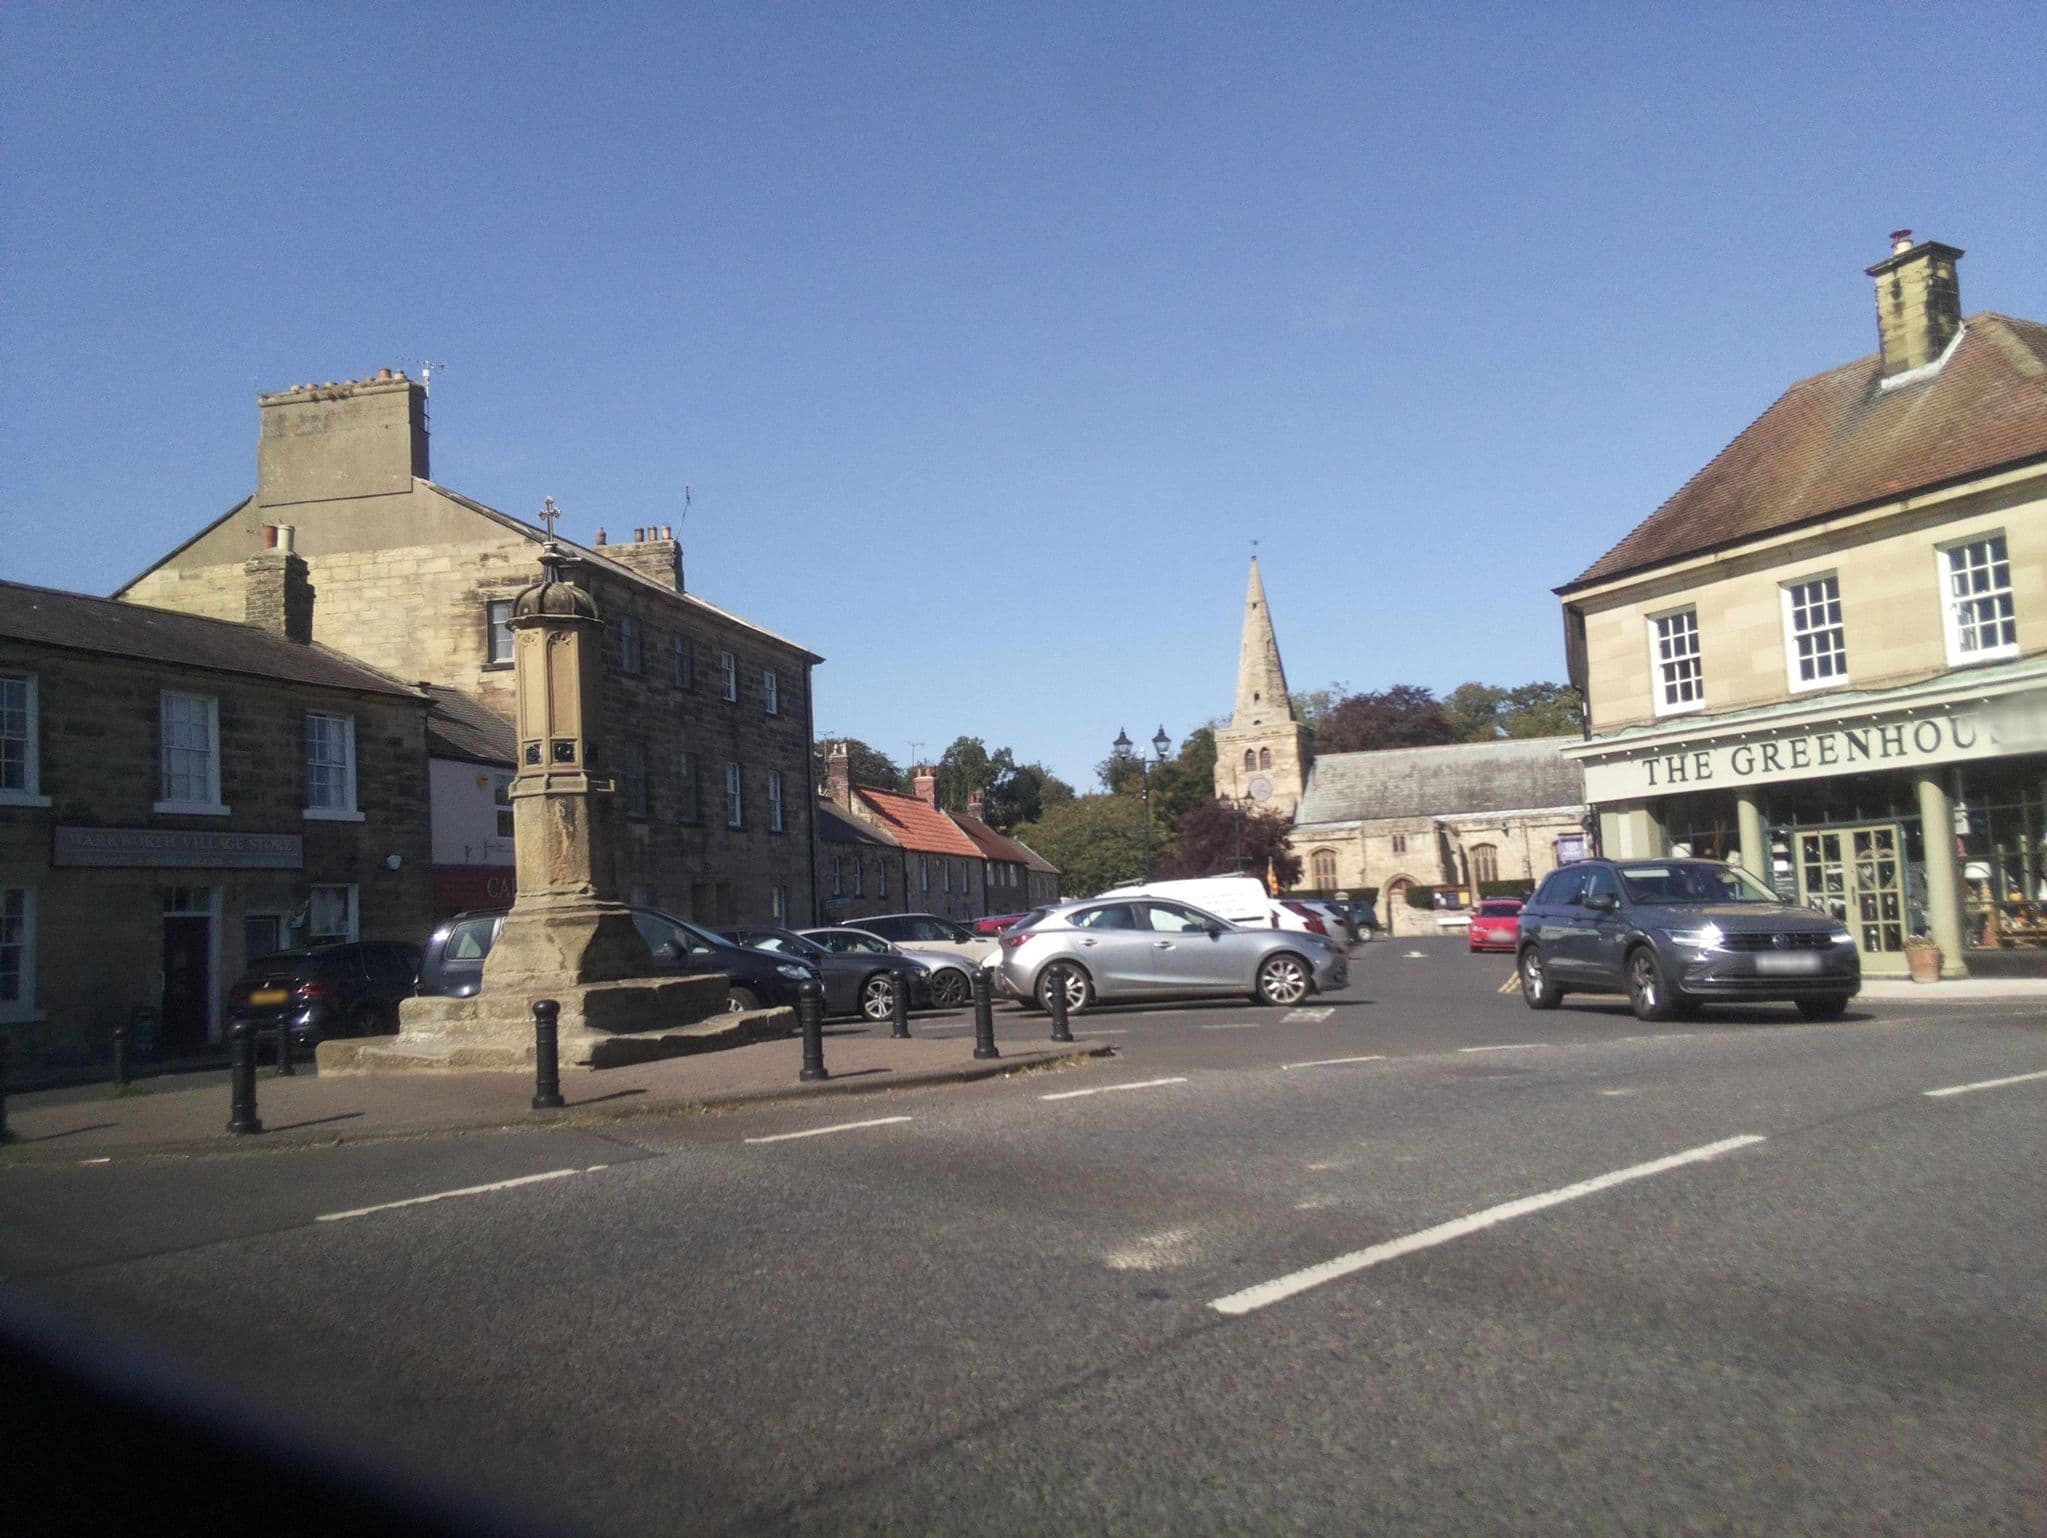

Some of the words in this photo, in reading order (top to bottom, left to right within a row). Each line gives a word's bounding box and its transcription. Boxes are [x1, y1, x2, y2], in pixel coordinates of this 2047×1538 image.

[1642, 751, 1713, 787] THE
[1731, 713, 2001, 776] GREENHOU
[182, 835, 245, 850] VILLAGE
